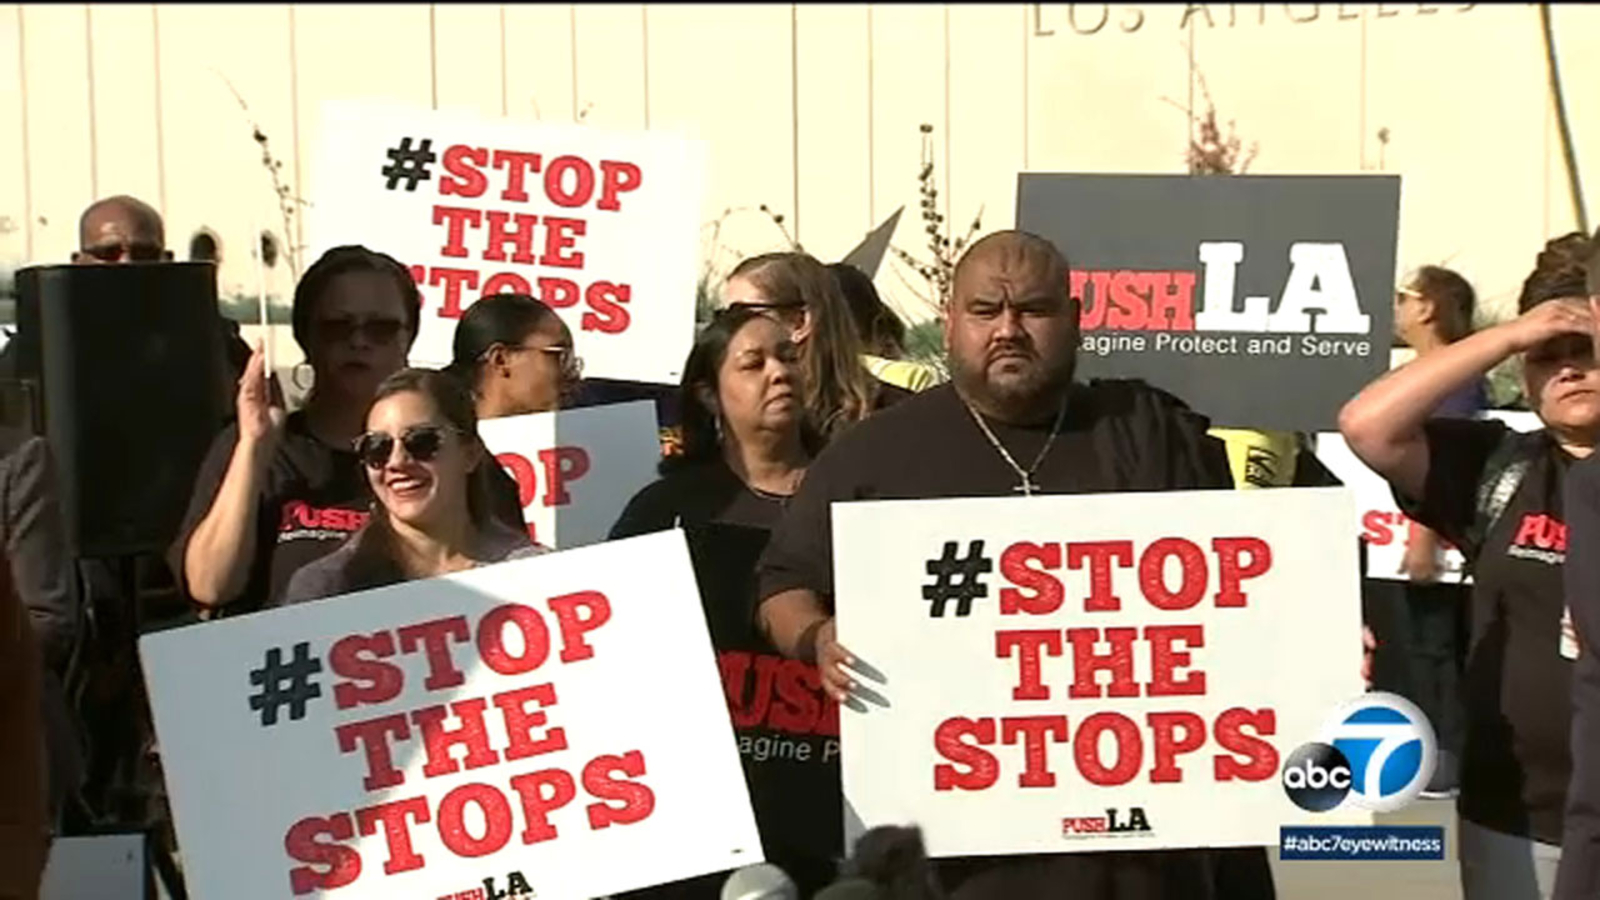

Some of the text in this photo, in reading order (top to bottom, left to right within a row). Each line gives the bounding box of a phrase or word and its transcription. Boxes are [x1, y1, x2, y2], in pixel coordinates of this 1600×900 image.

[382, 137, 643, 211] #STOP
[432, 204, 587, 270] THE
[407, 264, 632, 335] TPS
[1069, 269, 1196, 331] USH
[1081, 332, 1371, 356] agine Protect and Serve
[494, 446, 591, 507] OP
[922, 536, 1274, 618] #STOP
[248, 589, 612, 727] #STOP
[994, 623, 1208, 702] THE
[334, 682, 569, 791] THE
[739, 735, 811, 761] agine
[933, 707, 1281, 792] STOPS
[284, 749, 656, 894] STOPS
